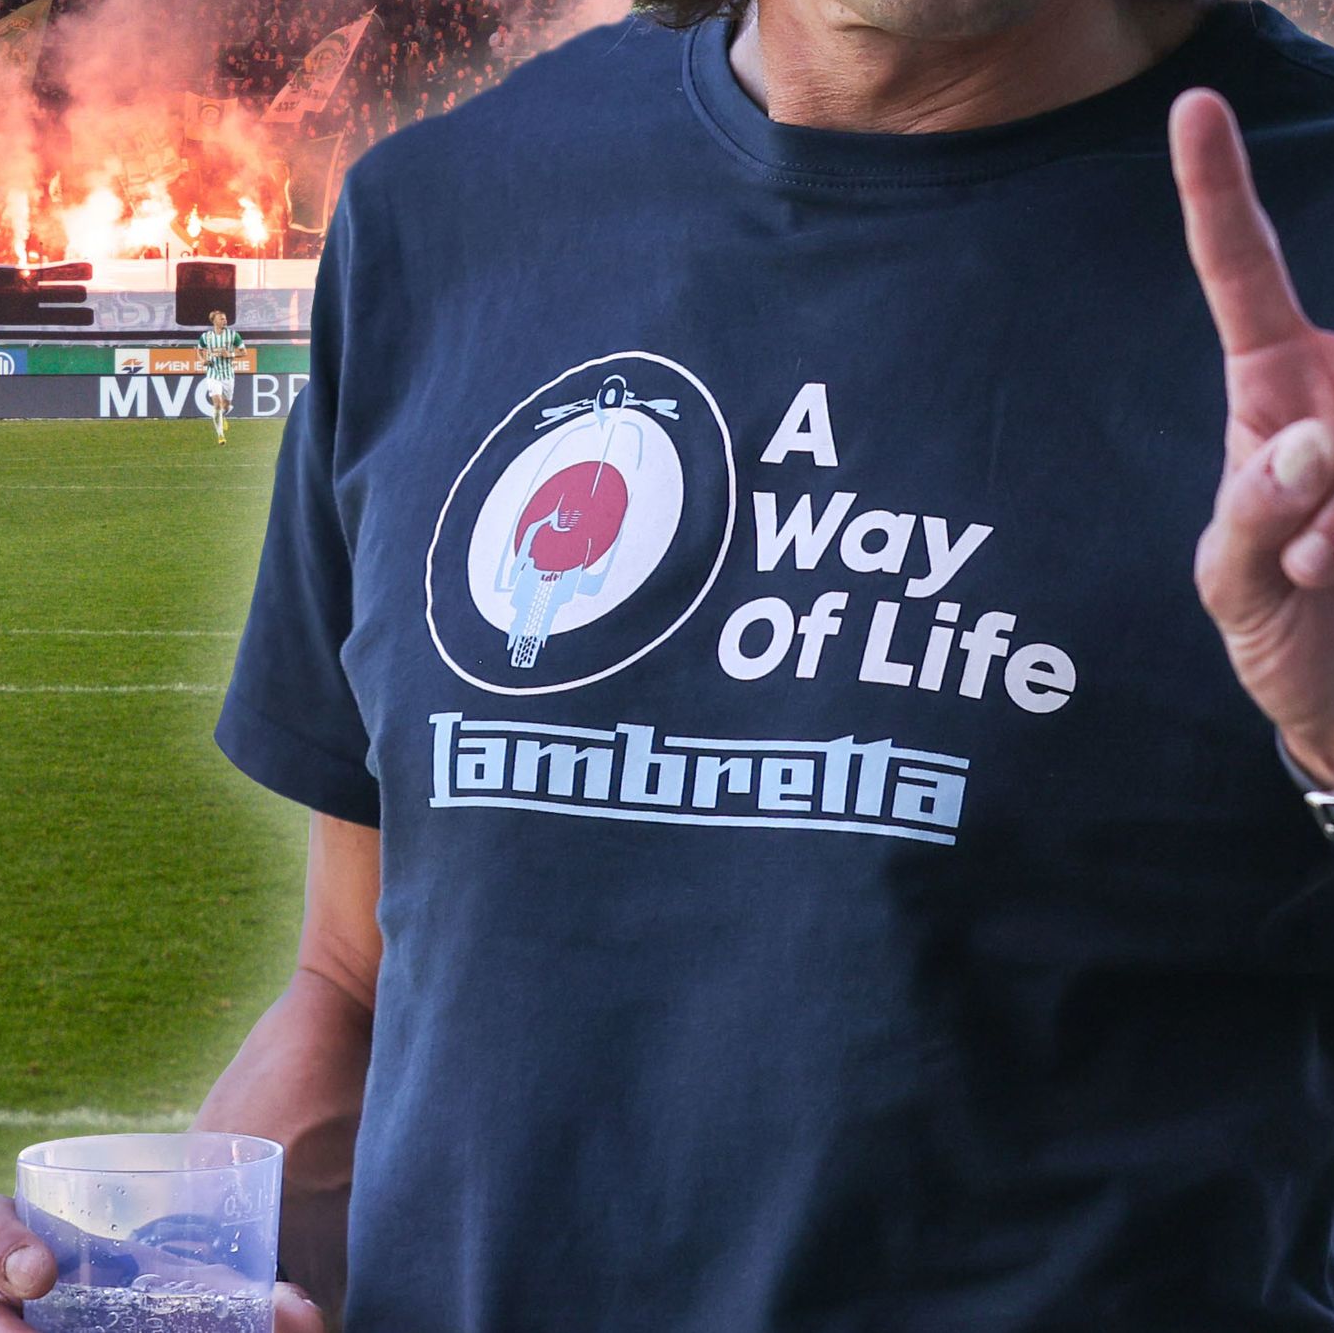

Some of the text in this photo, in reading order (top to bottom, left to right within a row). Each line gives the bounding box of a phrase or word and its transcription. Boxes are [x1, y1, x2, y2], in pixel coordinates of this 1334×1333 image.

[155, 361, 189, 372] WIEN
[760, 382, 838, 467] A
[752, 490, 994, 599] Way
[717, 591, 1077, 714] Of Life
